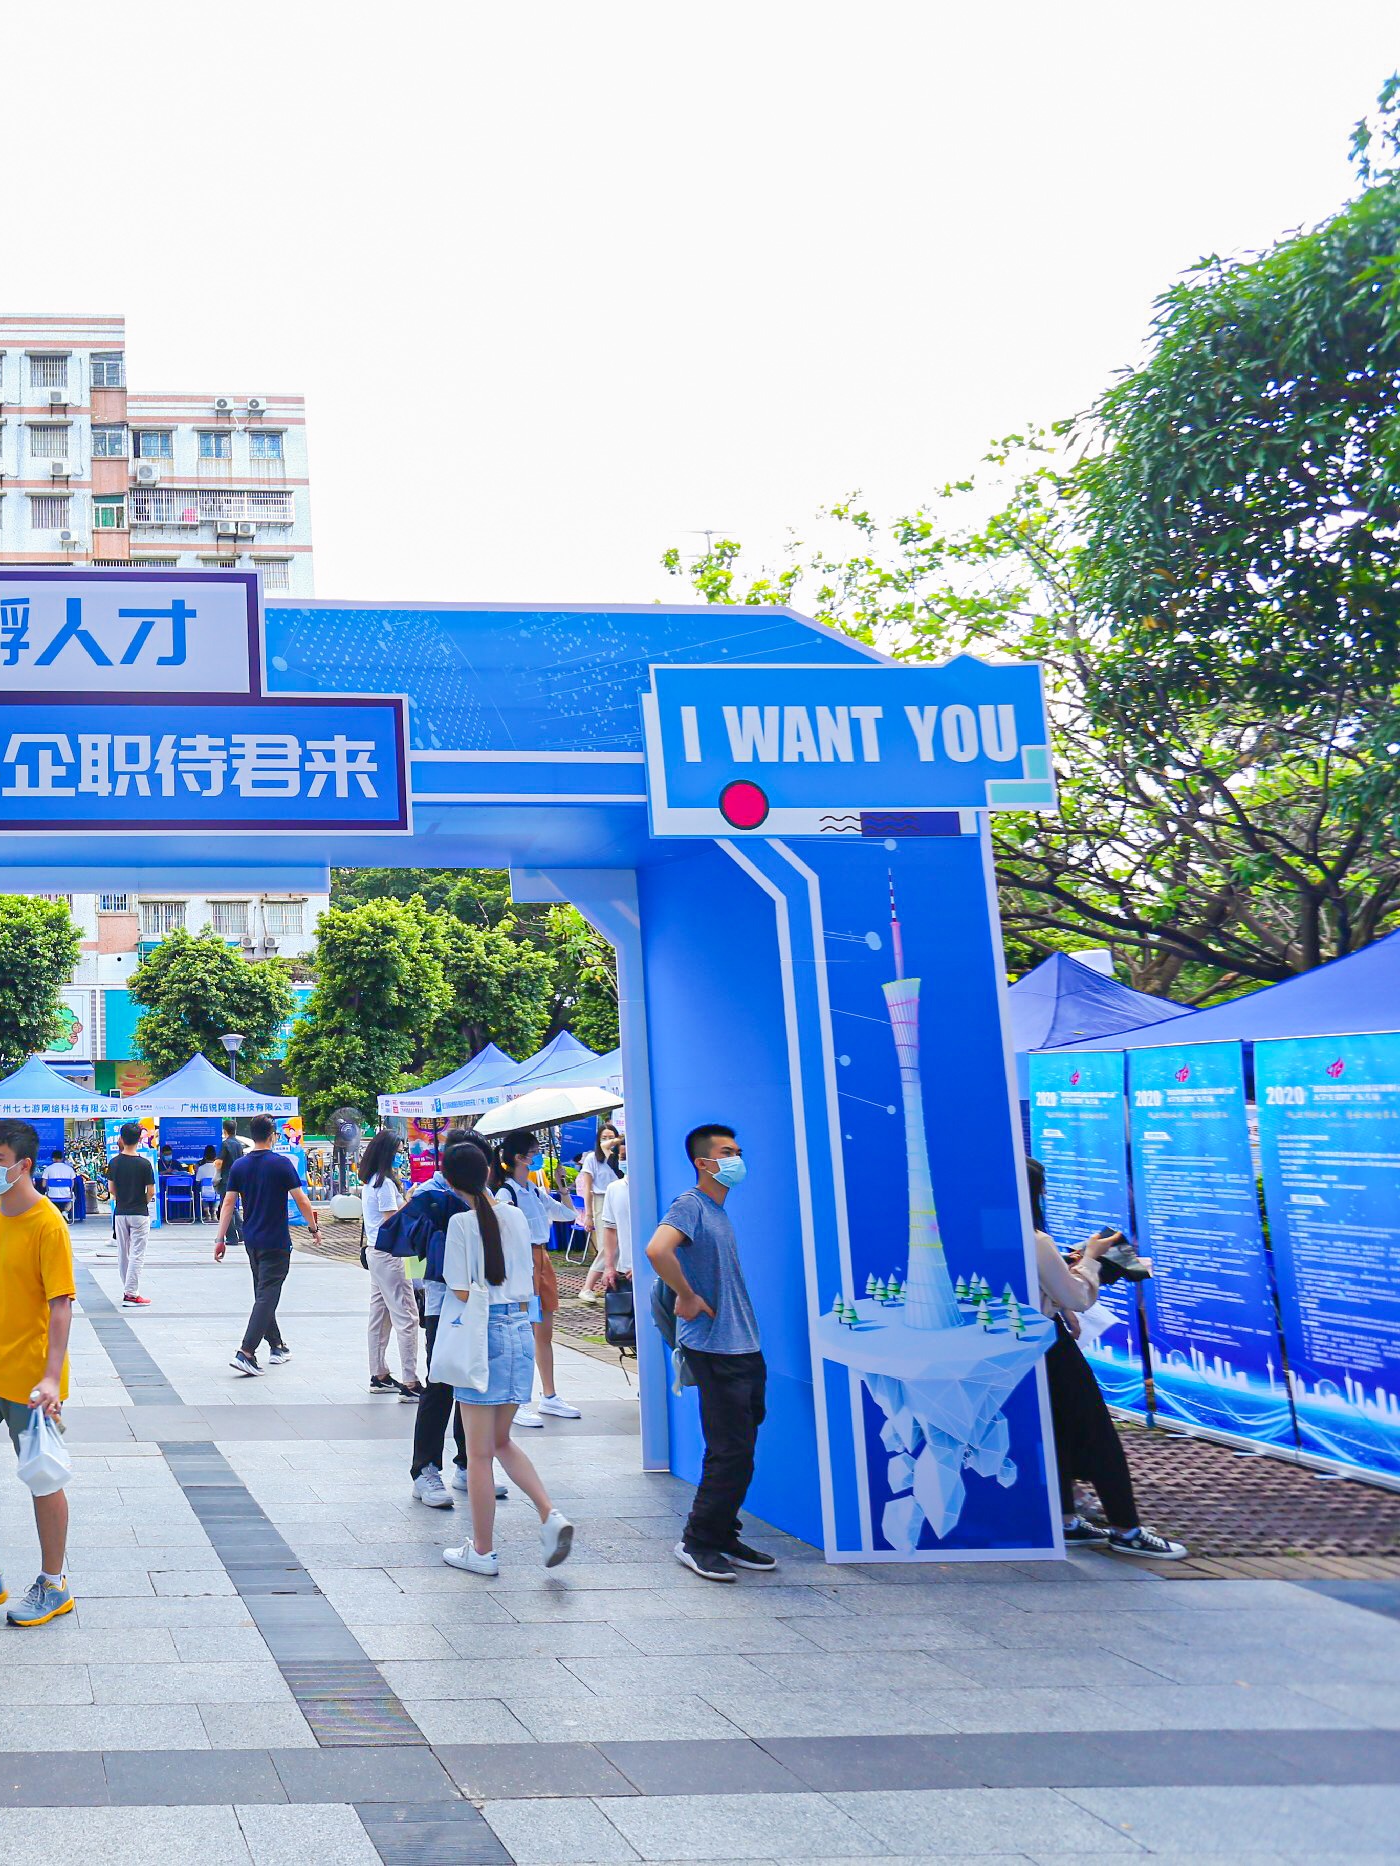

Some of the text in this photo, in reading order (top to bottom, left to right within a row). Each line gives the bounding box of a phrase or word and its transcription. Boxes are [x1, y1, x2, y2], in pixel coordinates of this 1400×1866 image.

[680, 703, 1018, 763] I WANT YOU
[1035, 1091, 1057, 1107] 2020
[1134, 1090, 1162, 1107] 2020
[1265, 1086, 1306, 1105] 2020
[122, 1104, 133, 1112] 06
